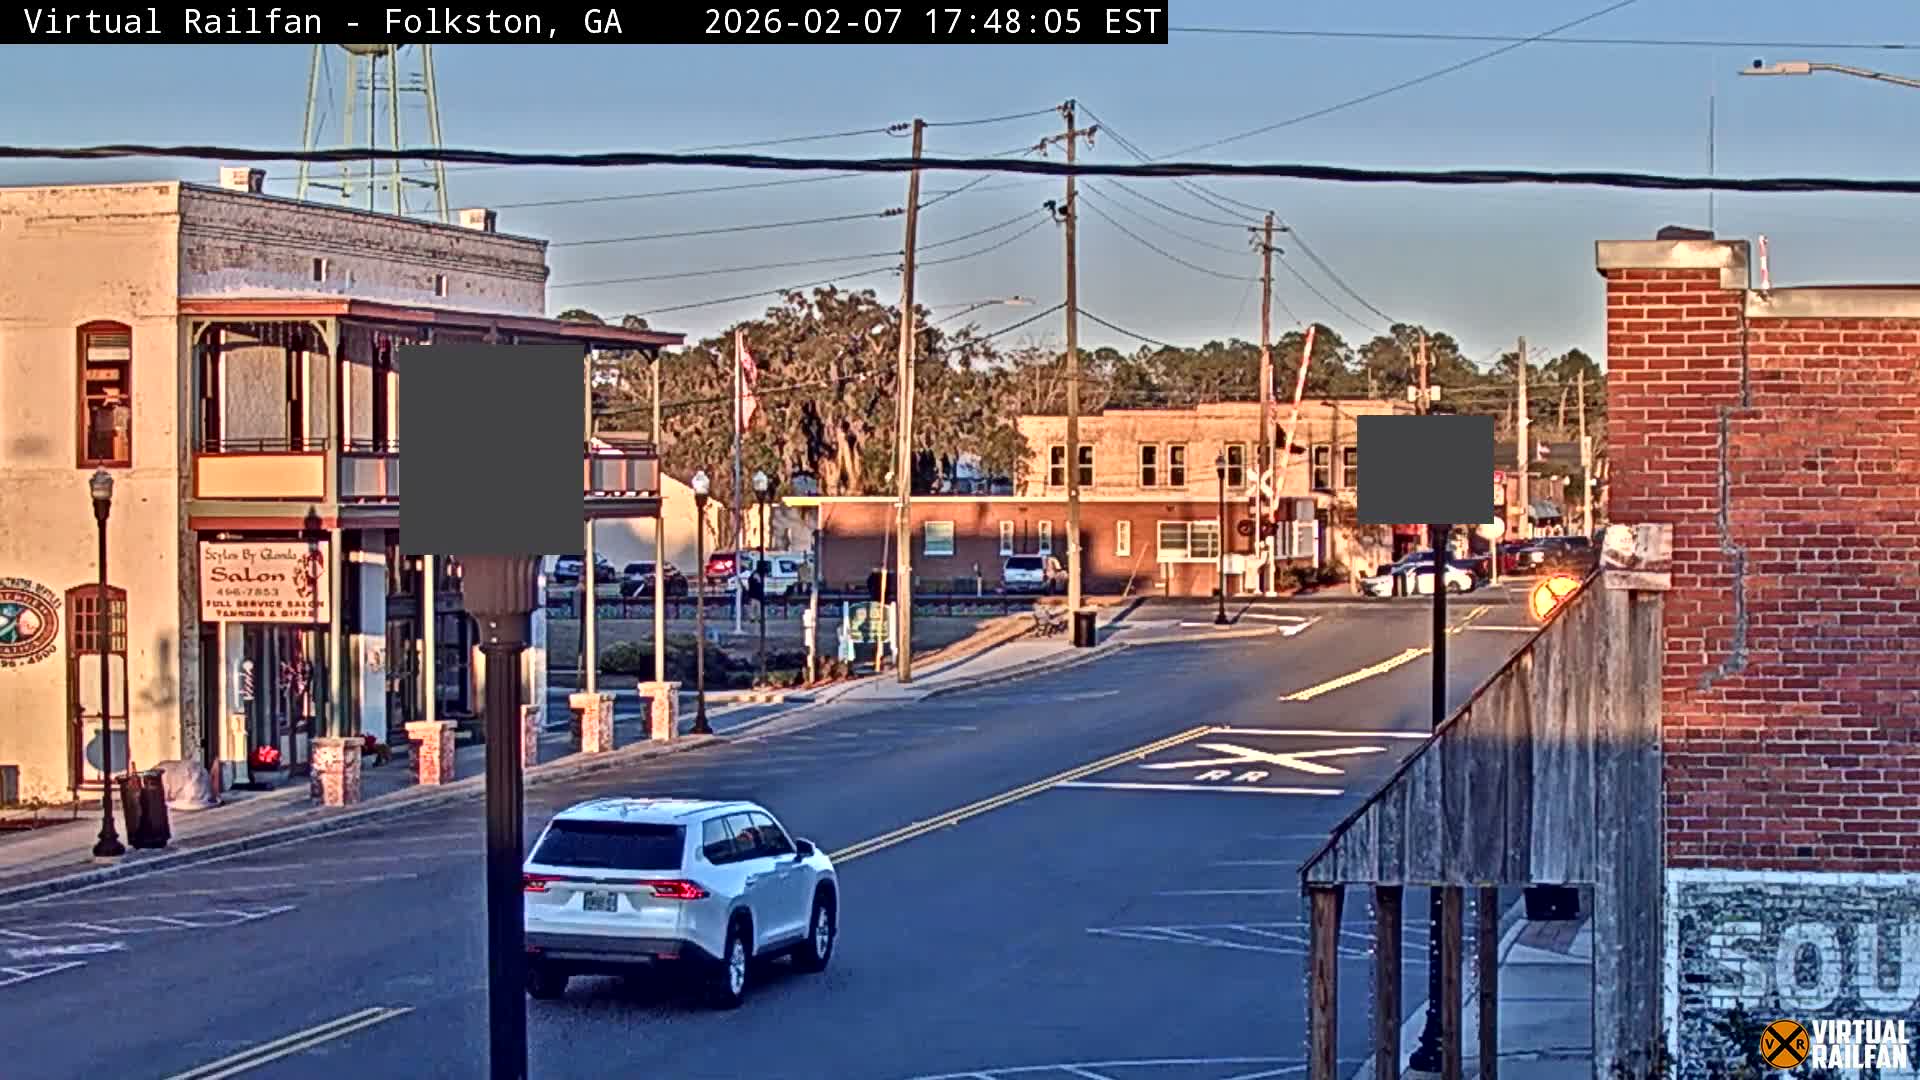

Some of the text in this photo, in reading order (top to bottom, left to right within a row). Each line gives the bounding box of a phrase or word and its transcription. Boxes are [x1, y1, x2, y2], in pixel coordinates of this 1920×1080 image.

[242, 548, 257, 565] By
[210, 566, 285, 582] Salon
[206, 599, 325, 608] FULL SERVICE SALON
[216, 609, 265, 618] TANNING
[281, 610, 315, 618] GIFTS
